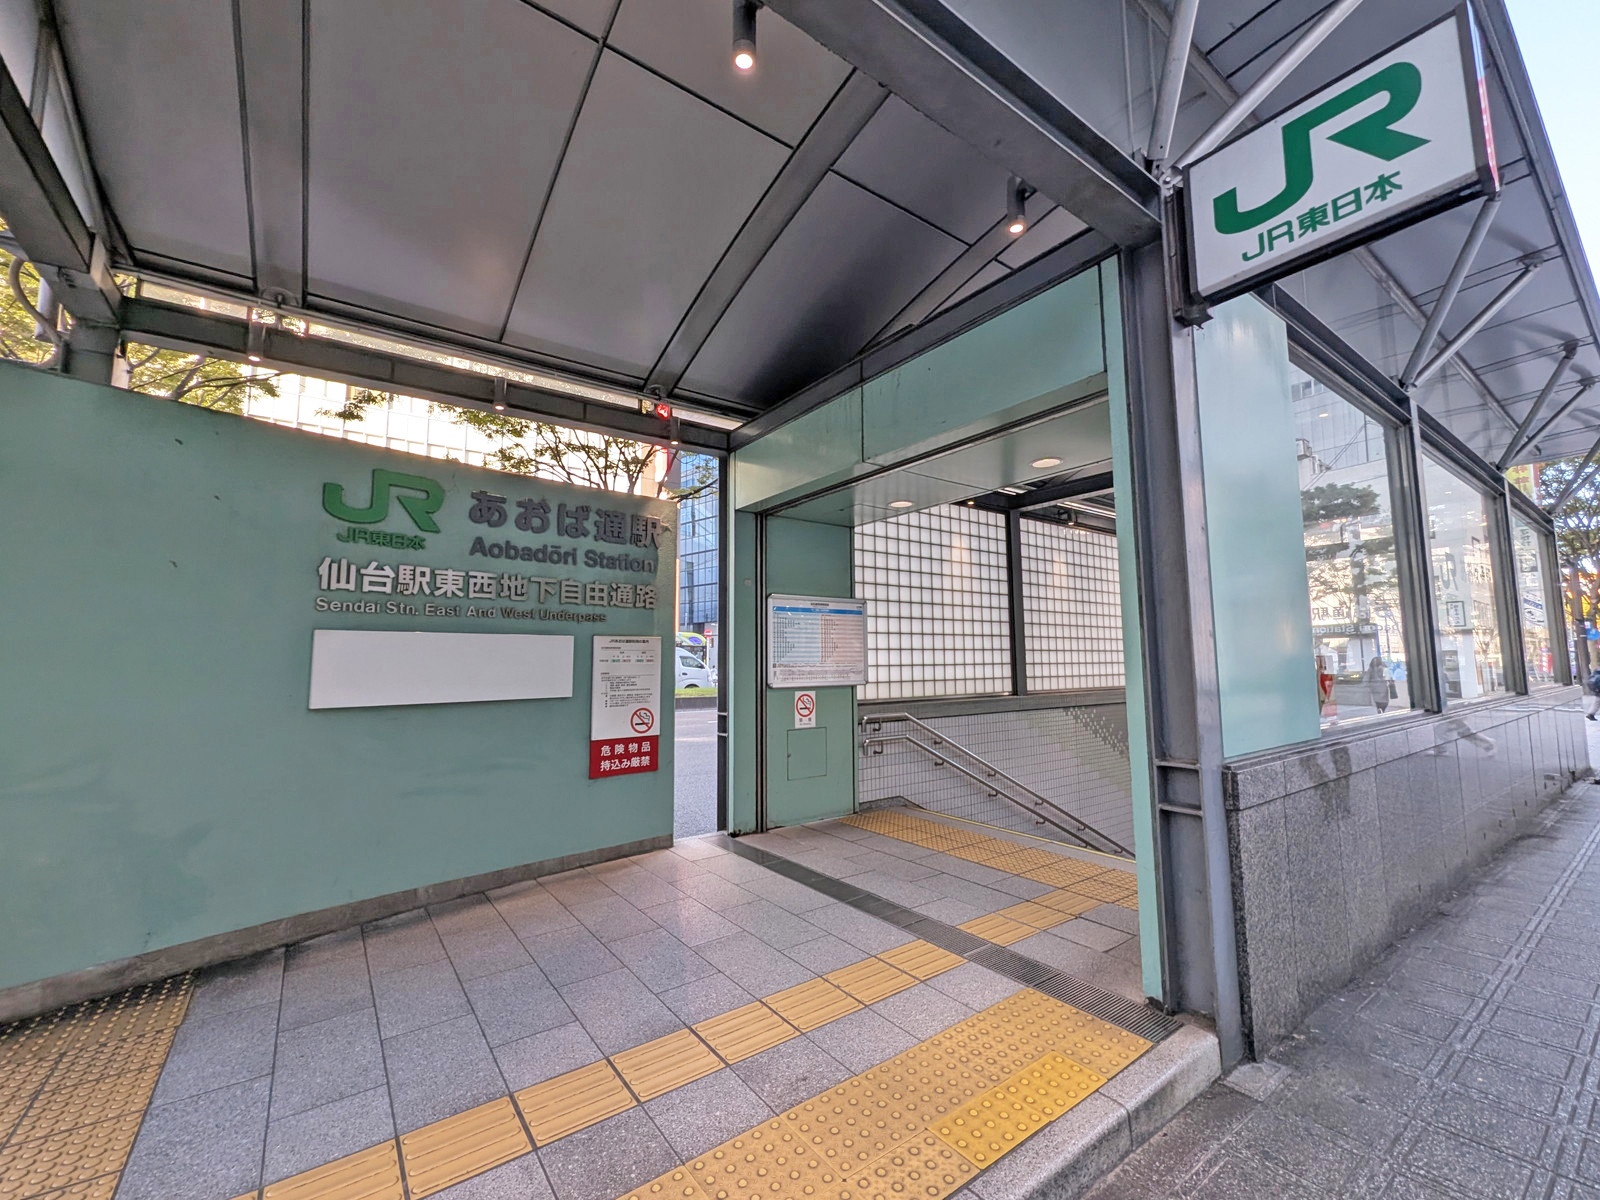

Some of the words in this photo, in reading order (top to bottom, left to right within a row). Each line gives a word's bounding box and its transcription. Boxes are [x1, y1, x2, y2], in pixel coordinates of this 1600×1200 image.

[1213, 61, 1432, 235] JR
[1241, 170, 1403, 262] JR東日本
[322, 468, 446, 534] JR
[468, 490, 662, 550] あおば通駅
[336, 526, 427, 551] JR東日本
[469, 536, 578, 567] Aobadōri
[583, 548, 657, 575] Station
[318, 556, 658, 610] 仙台駅東西地下自由通路
[315, 597, 381, 615] Sendai
[385, 600, 420, 617] Stn.
[424, 602, 461, 618] East
[466, 604, 497, 619] And
[501, 606, 536, 621] West
[538, 607, 608, 624] Underpass
[600, 741, 651, 757] 危険物品
[600, 755, 651, 772] 持込み厳禁
